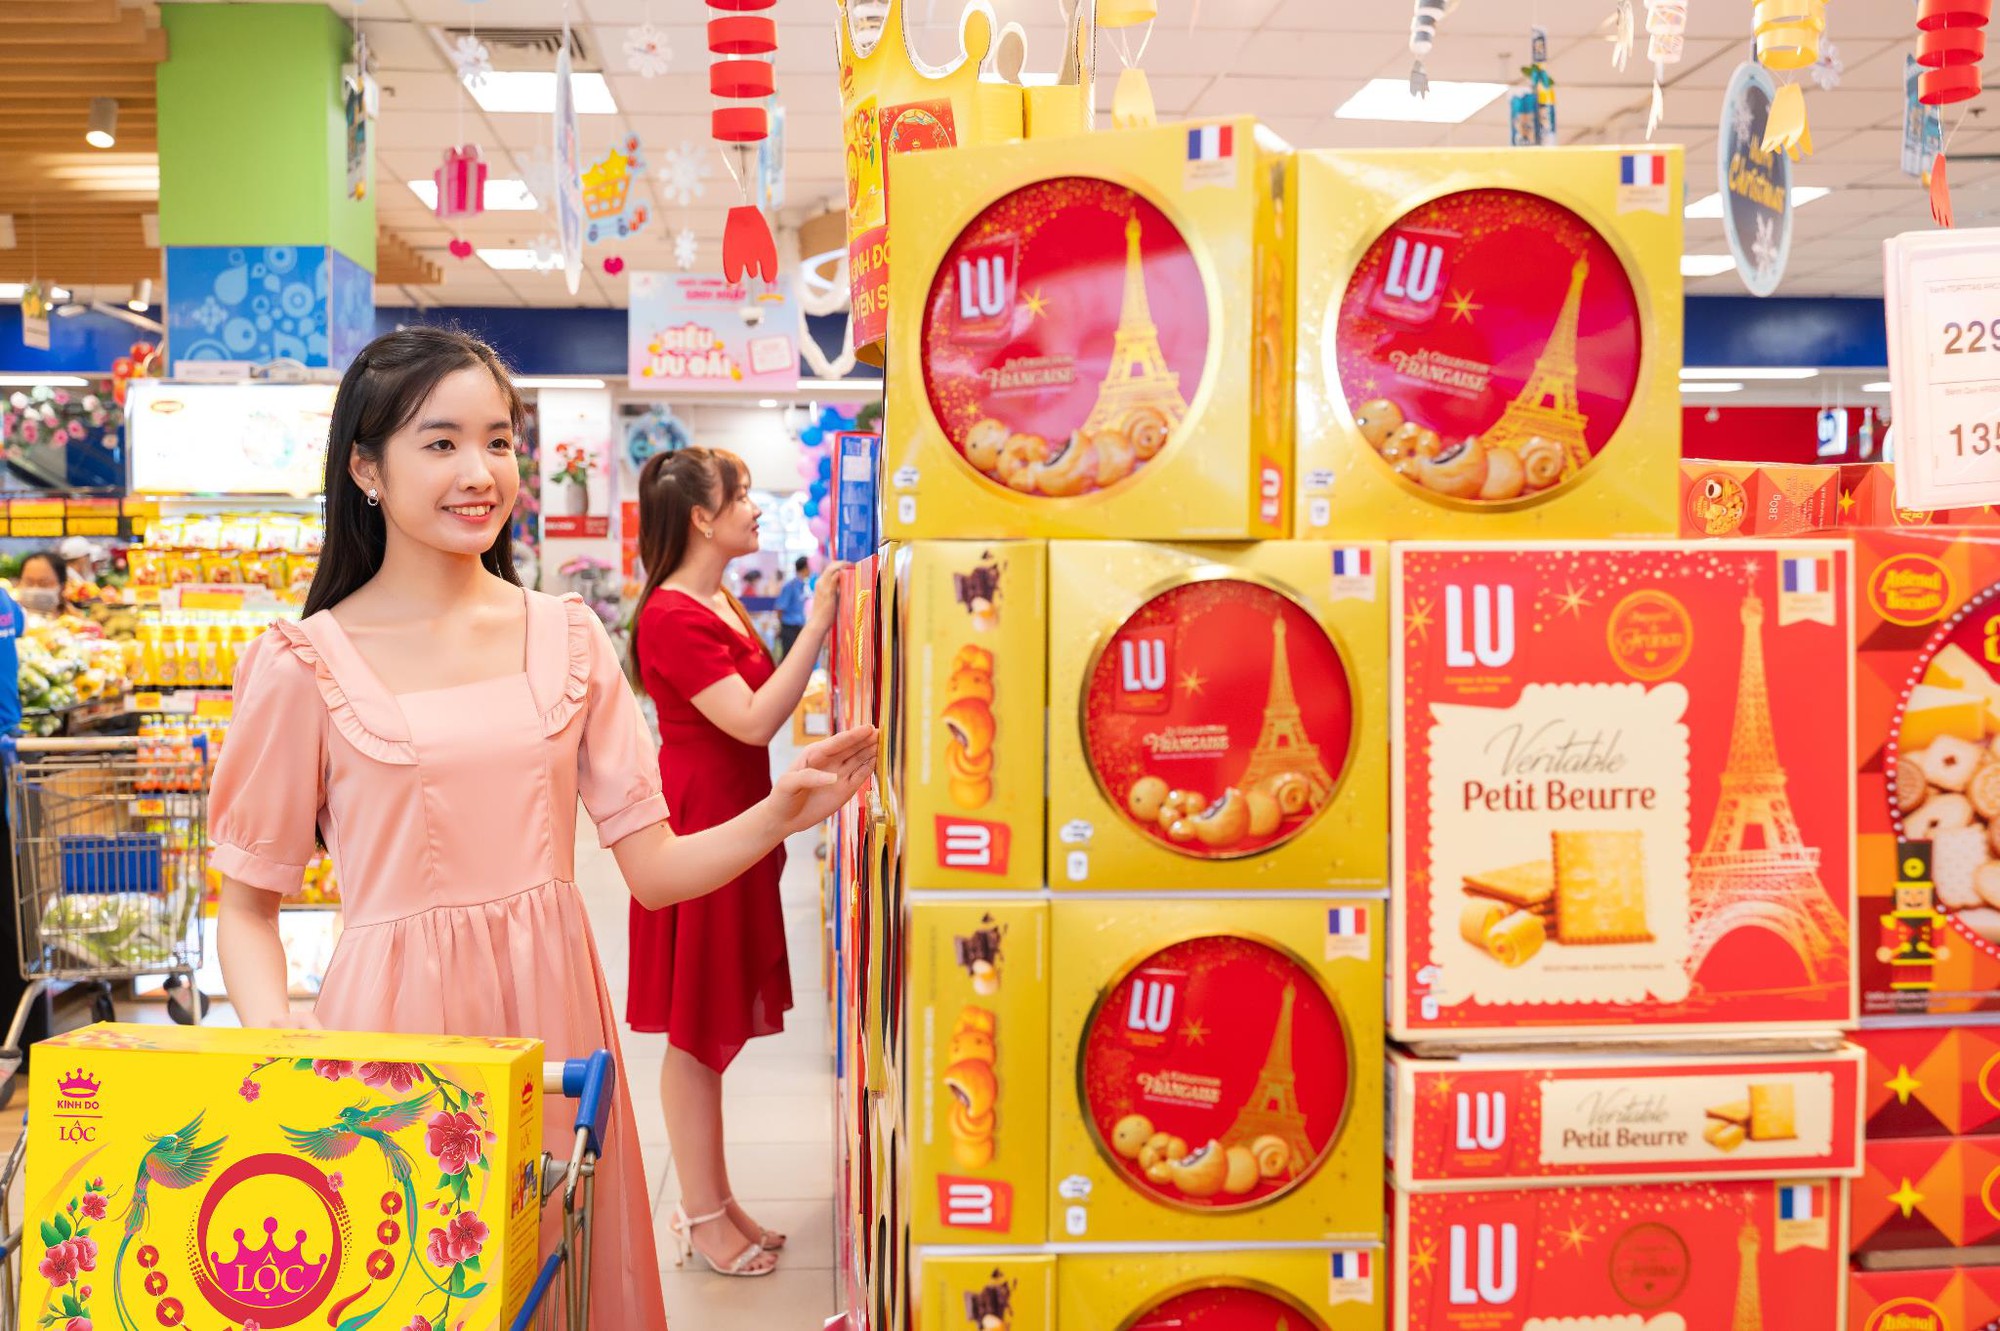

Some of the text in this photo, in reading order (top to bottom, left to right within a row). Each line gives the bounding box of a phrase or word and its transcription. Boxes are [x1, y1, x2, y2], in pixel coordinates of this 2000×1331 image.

[958, 256, 1005, 318] LU
[1384, 236, 1444, 302] LU
[1949, 422, 2000, 457] 13
[1768, 494, 1781, 520] 380g
[1446, 584, 1515, 667] LU
[1122, 639, 1166, 691] LU
[1463, 778, 1656, 811] Petit Beurre
[945, 824, 990, 865] LU
[1128, 979, 1175, 1032] LU
[57, 1100, 100, 1110] KINH DO
[1457, 1092, 1506, 1150] LU
[59, 1119, 96, 1144] LỘC
[1562, 1127, 1688, 1148] Petit Beurre
[948, 1184, 993, 1225] LU
[233, 1251, 305, 1300] LỘC
[1450, 1223, 1517, 1304] LU
